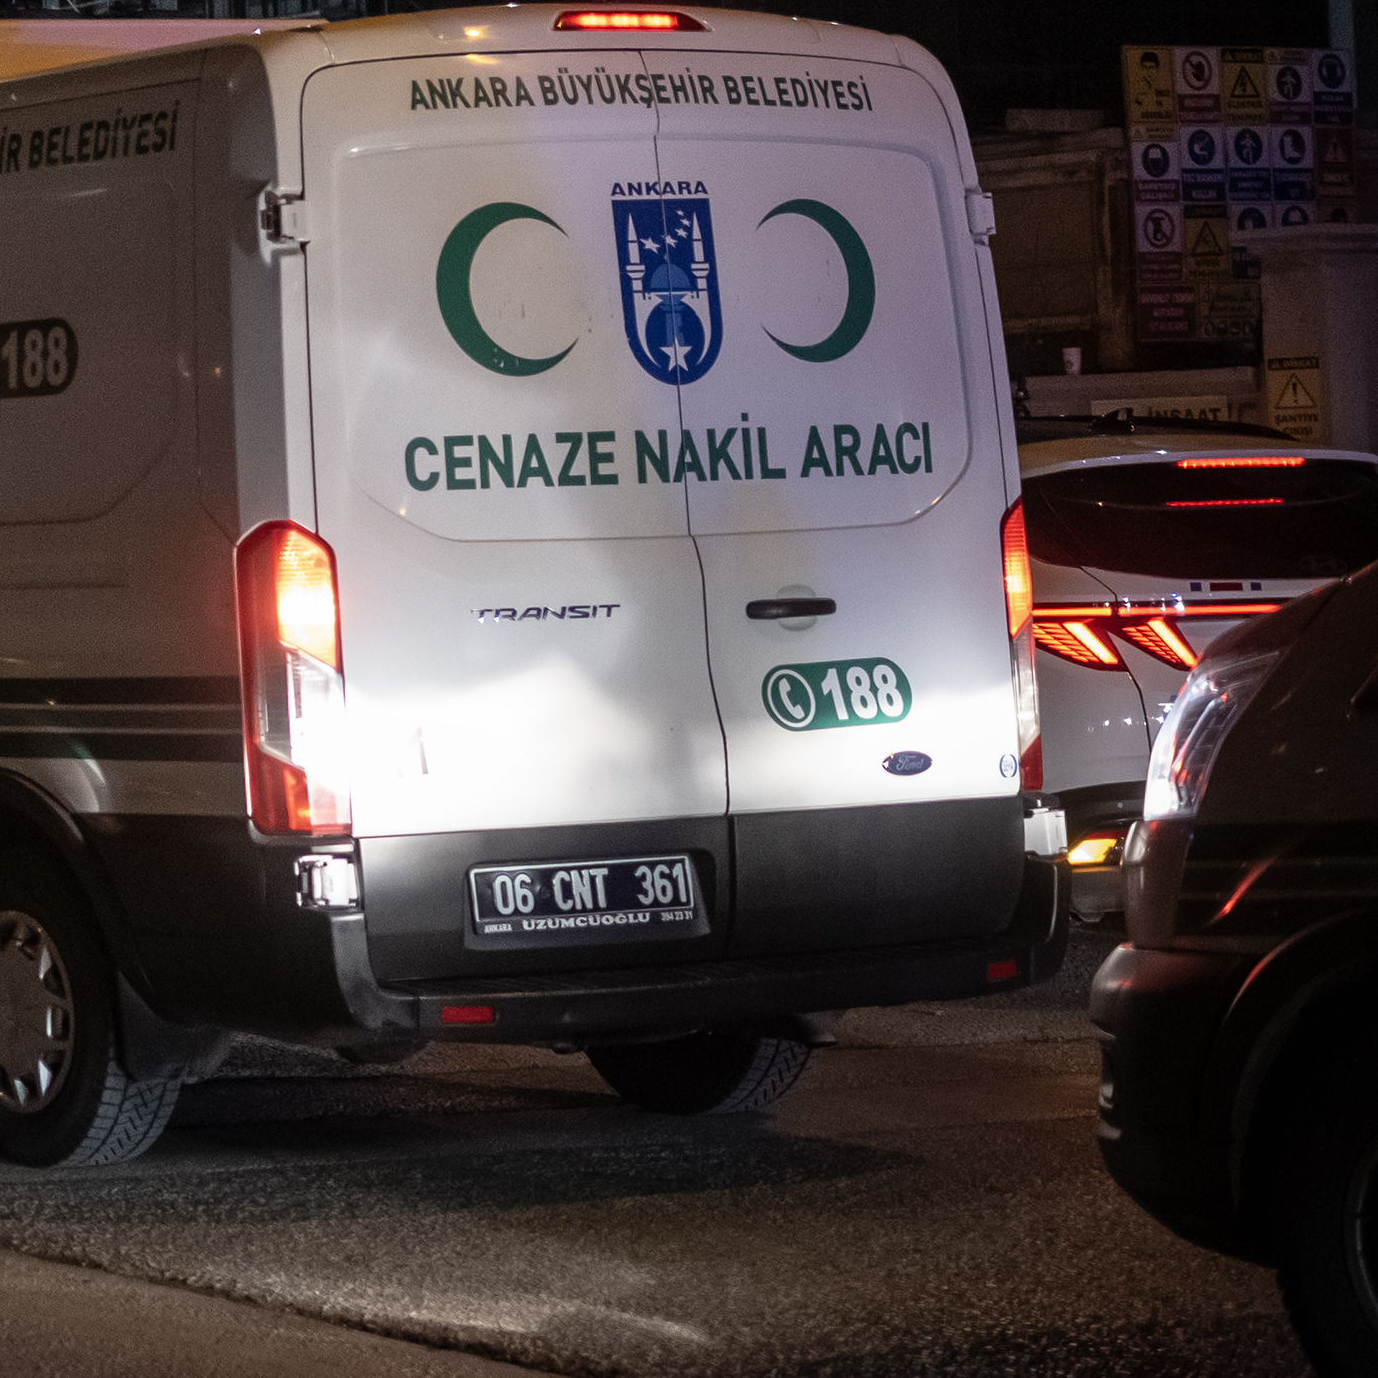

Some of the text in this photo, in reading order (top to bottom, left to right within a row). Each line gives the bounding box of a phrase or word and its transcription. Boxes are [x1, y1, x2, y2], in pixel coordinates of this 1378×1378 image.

[410, 68, 874, 113] ANKARA BÜYÜKŞEHİR BELEDİYESİ
[28, 100, 181, 168] BELEDİYESİ
[610, 181, 709, 198] ANKARA
[2, 327, 68, 389] 188
[404, 412, 934, 493] CENAZE NAKİL ARACI
[471, 603, 621, 624] TRANSIT
[820, 664, 906, 721] 188
[493, 862, 690, 916] 06 CNT 361
